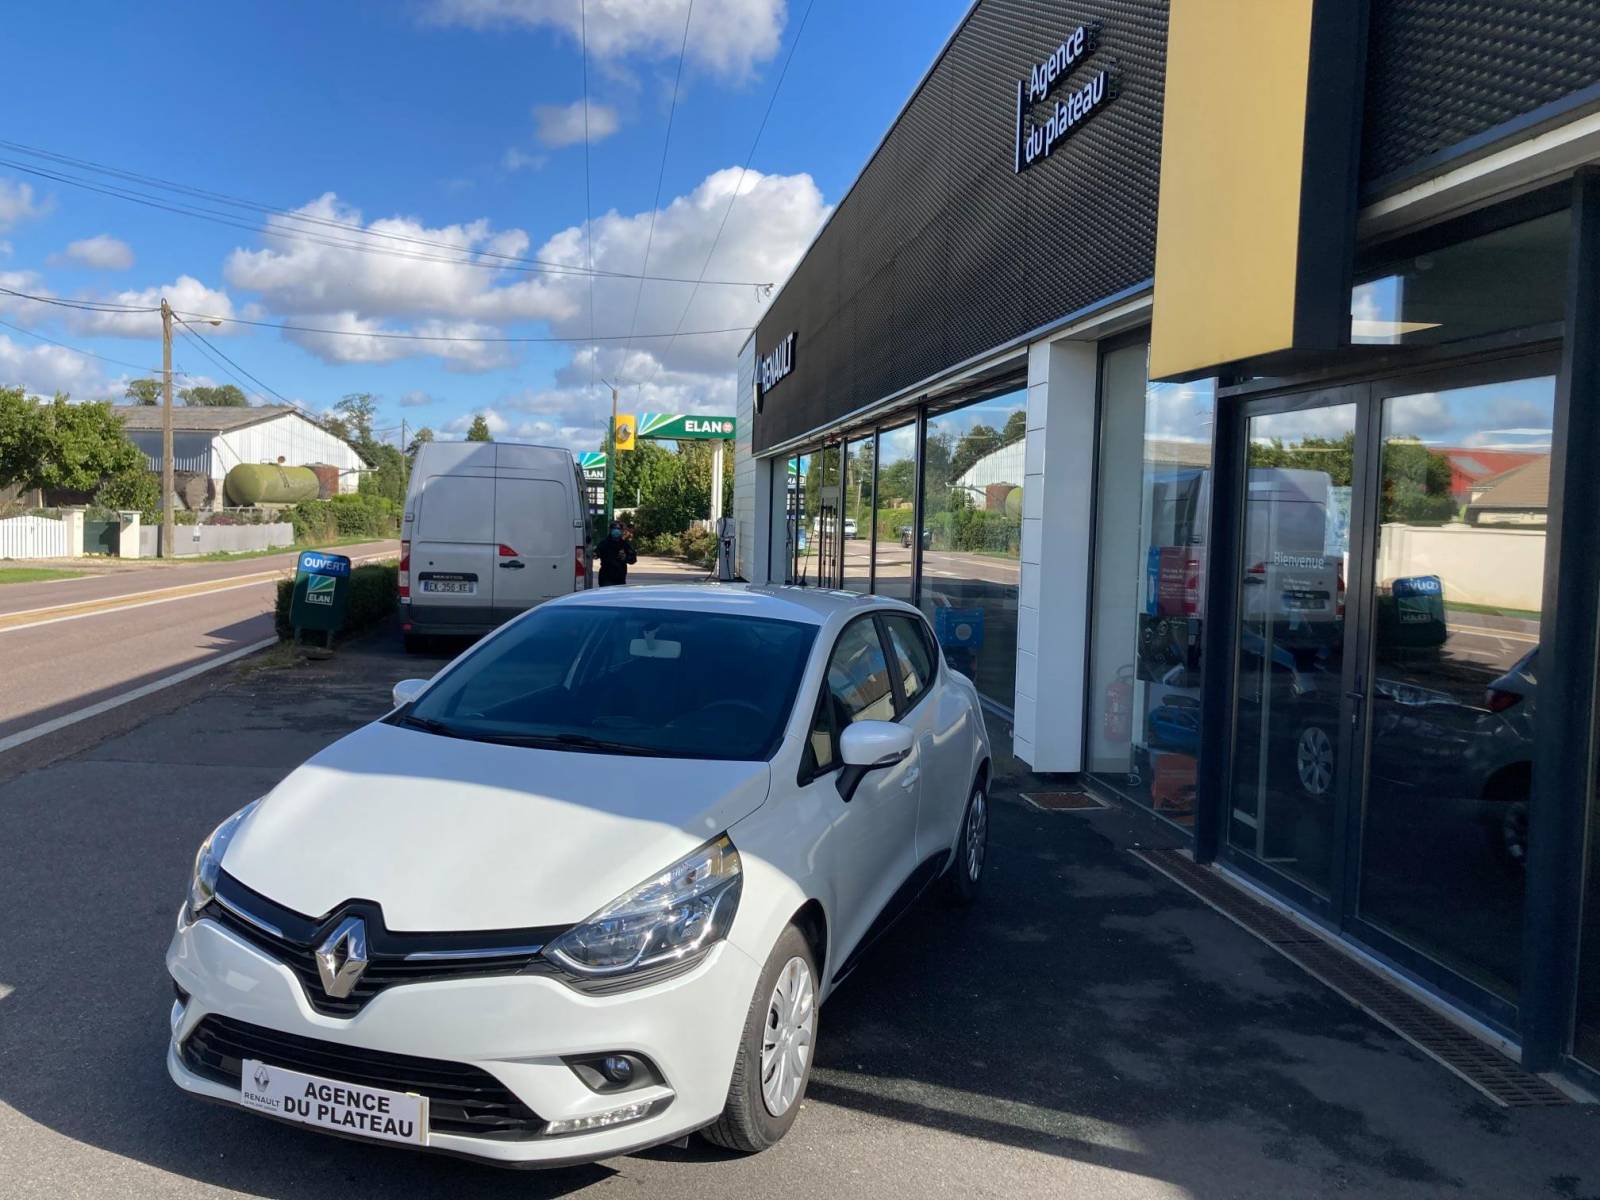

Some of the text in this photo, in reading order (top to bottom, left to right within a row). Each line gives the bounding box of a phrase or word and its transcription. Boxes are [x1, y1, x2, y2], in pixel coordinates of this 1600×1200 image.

[1030, 26, 1084, 103] Agence
[1025, 71, 1104, 163] du plateau
[685, 420, 722, 433] ELAN
[304, 557, 346, 571] OUVERT
[1274, 551, 1325, 569] Bienvenue
[308, 593, 331, 602] ELAN
[244, 1091, 280, 1108] RENAULT
[304, 1082, 390, 1114] AGENCE
[283, 1095, 310, 1117] DU
[317, 1104, 413, 1138] PLATEAU
